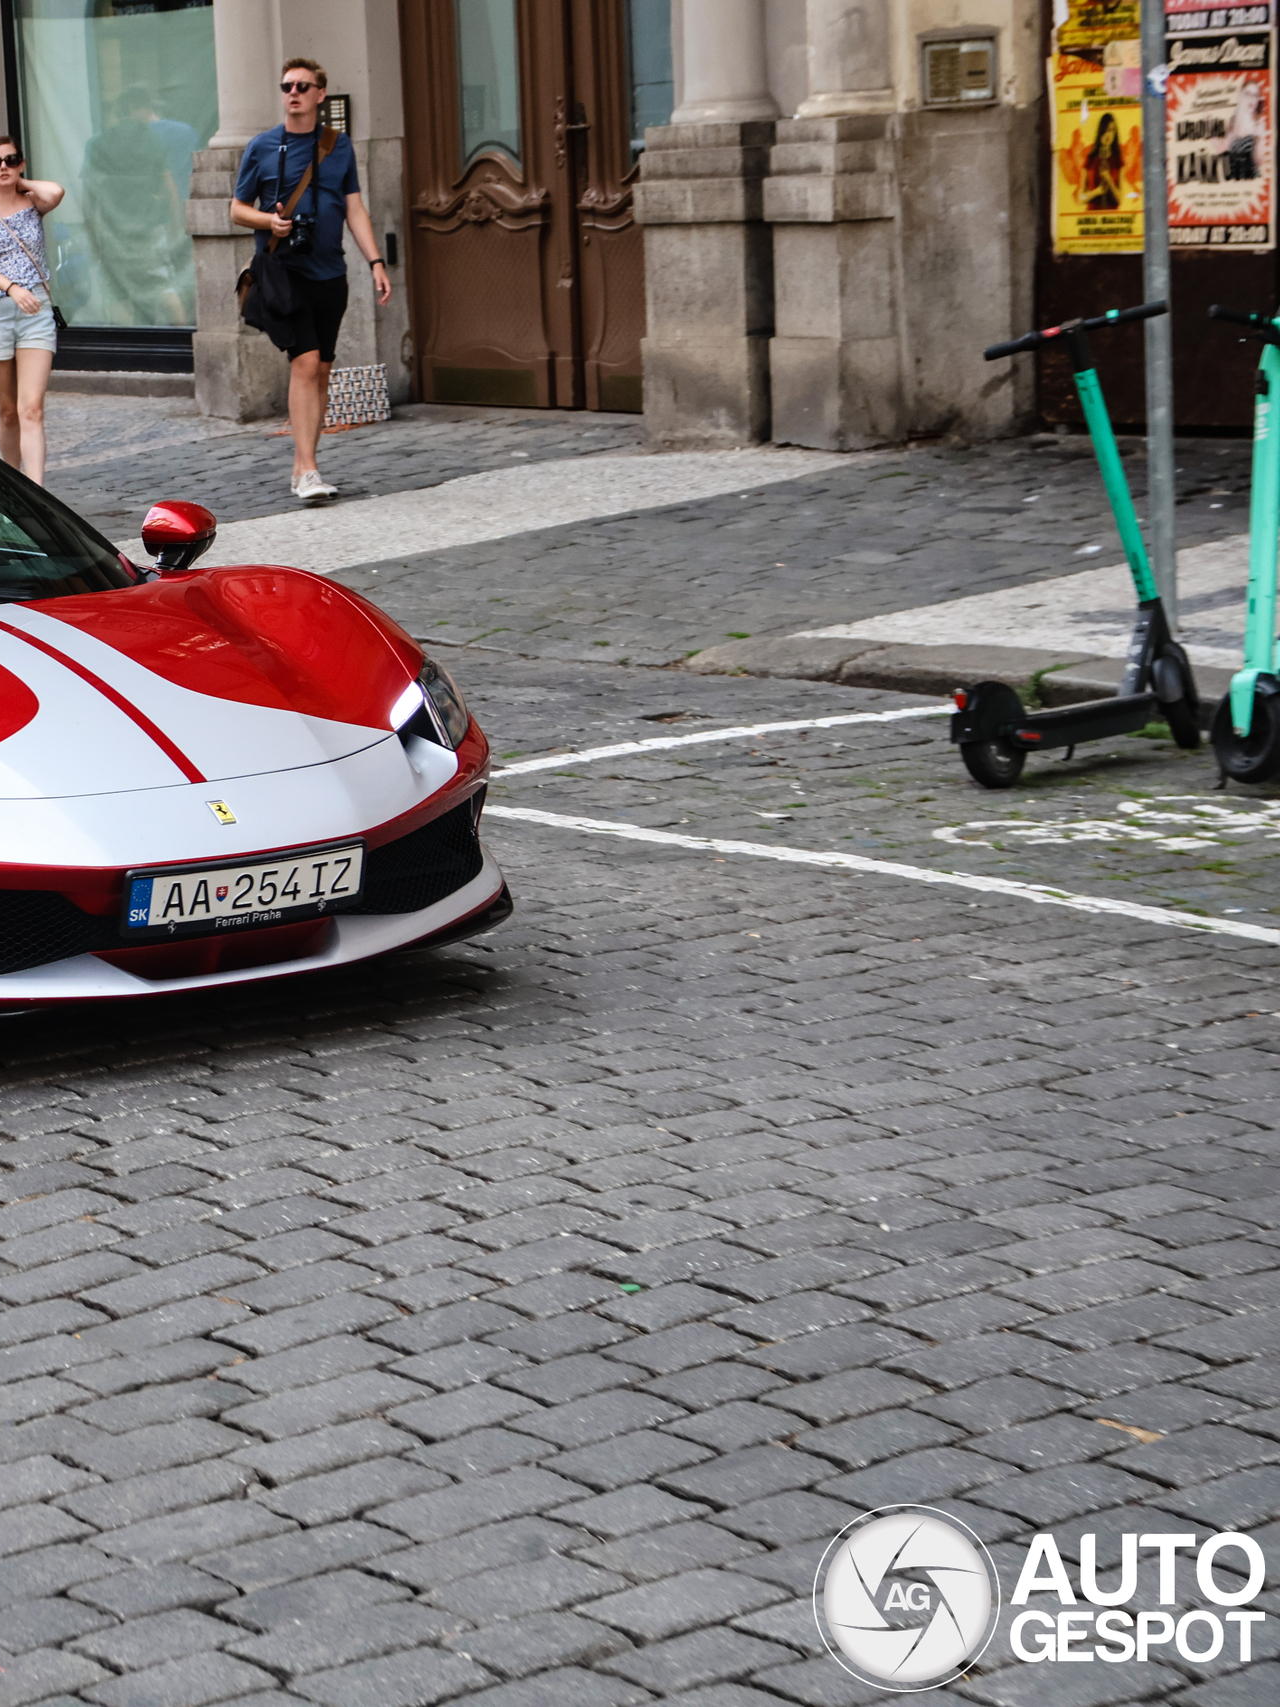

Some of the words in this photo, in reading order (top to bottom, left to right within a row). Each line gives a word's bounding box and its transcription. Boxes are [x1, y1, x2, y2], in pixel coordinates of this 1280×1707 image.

[161, 878, 211, 919] AA
[129, 908, 149, 922] SK
[215, 912, 251, 928] Ferrari
[252, 909, 282, 924] Praha
